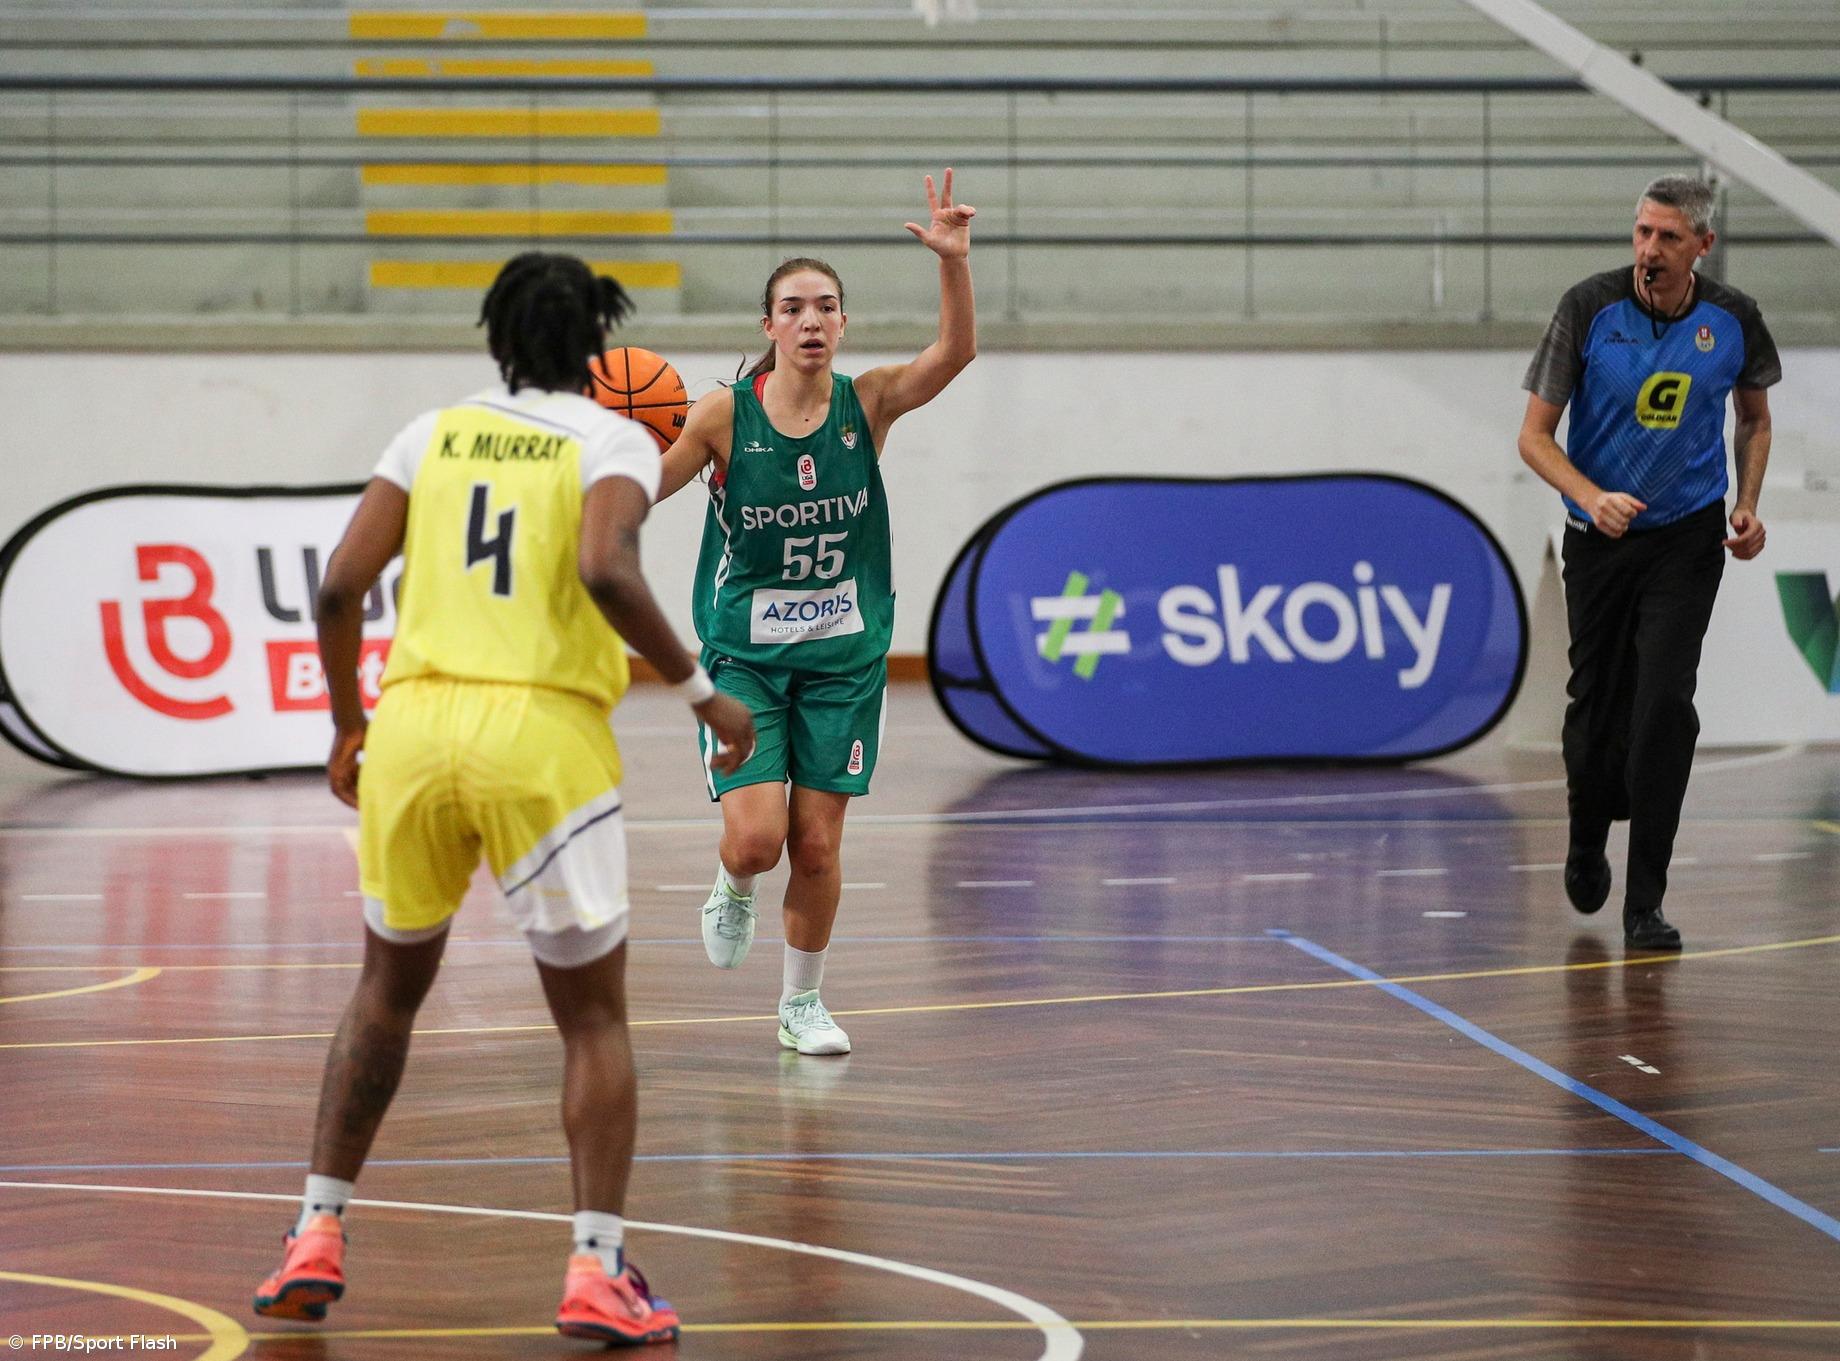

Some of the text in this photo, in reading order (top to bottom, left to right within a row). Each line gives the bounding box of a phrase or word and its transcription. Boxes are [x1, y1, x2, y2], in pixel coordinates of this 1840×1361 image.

[440, 432, 569, 462] K. MURRAY
[741, 486, 869, 530] SPORTIVA
[465, 482, 518, 598] 4
[782, 531, 849, 581] 55
[762, 592, 852, 622] AZORIS
